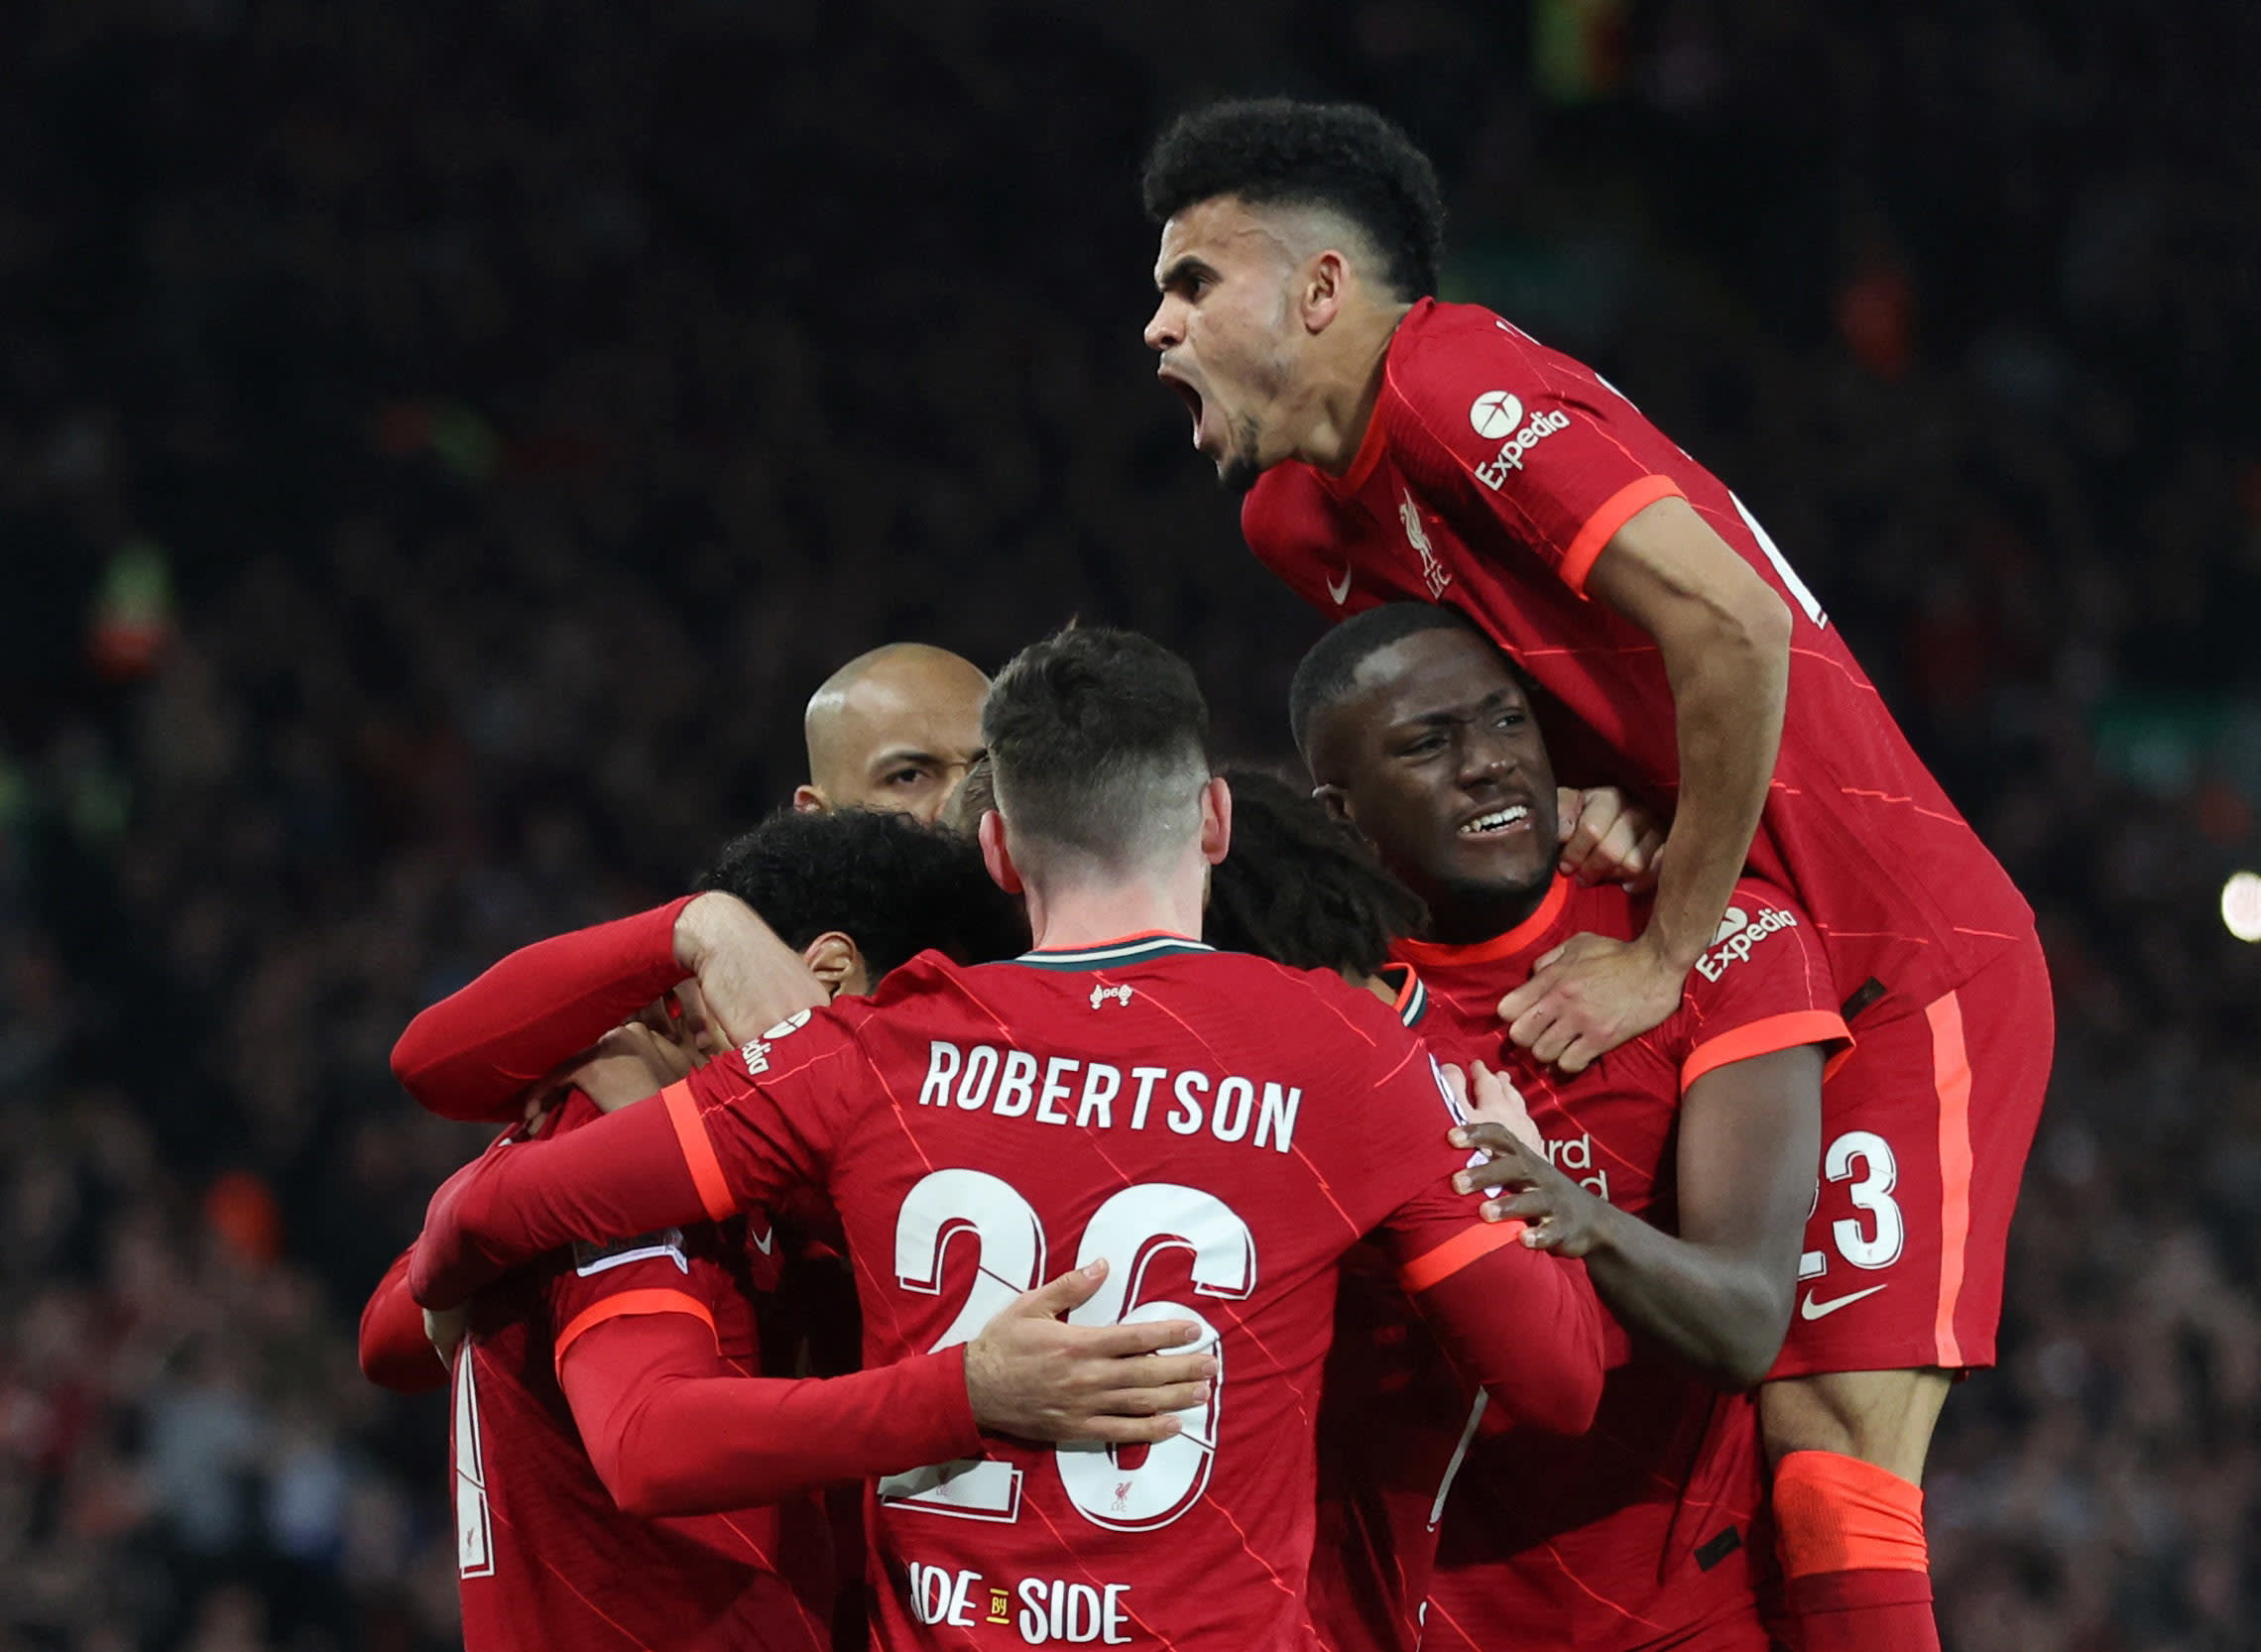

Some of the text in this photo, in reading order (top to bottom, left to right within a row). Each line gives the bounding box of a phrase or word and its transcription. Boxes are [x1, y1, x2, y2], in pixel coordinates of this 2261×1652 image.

[1474, 409, 1571, 492] Expedia
[1696, 906, 1798, 984] Expedia
[918, 1039, 1303, 1154] ROBERTSON
[876, 1167, 1257, 1533] 26
[910, 1562, 984, 1627] IDE
[1017, 1576, 1132, 1645] SIDE
